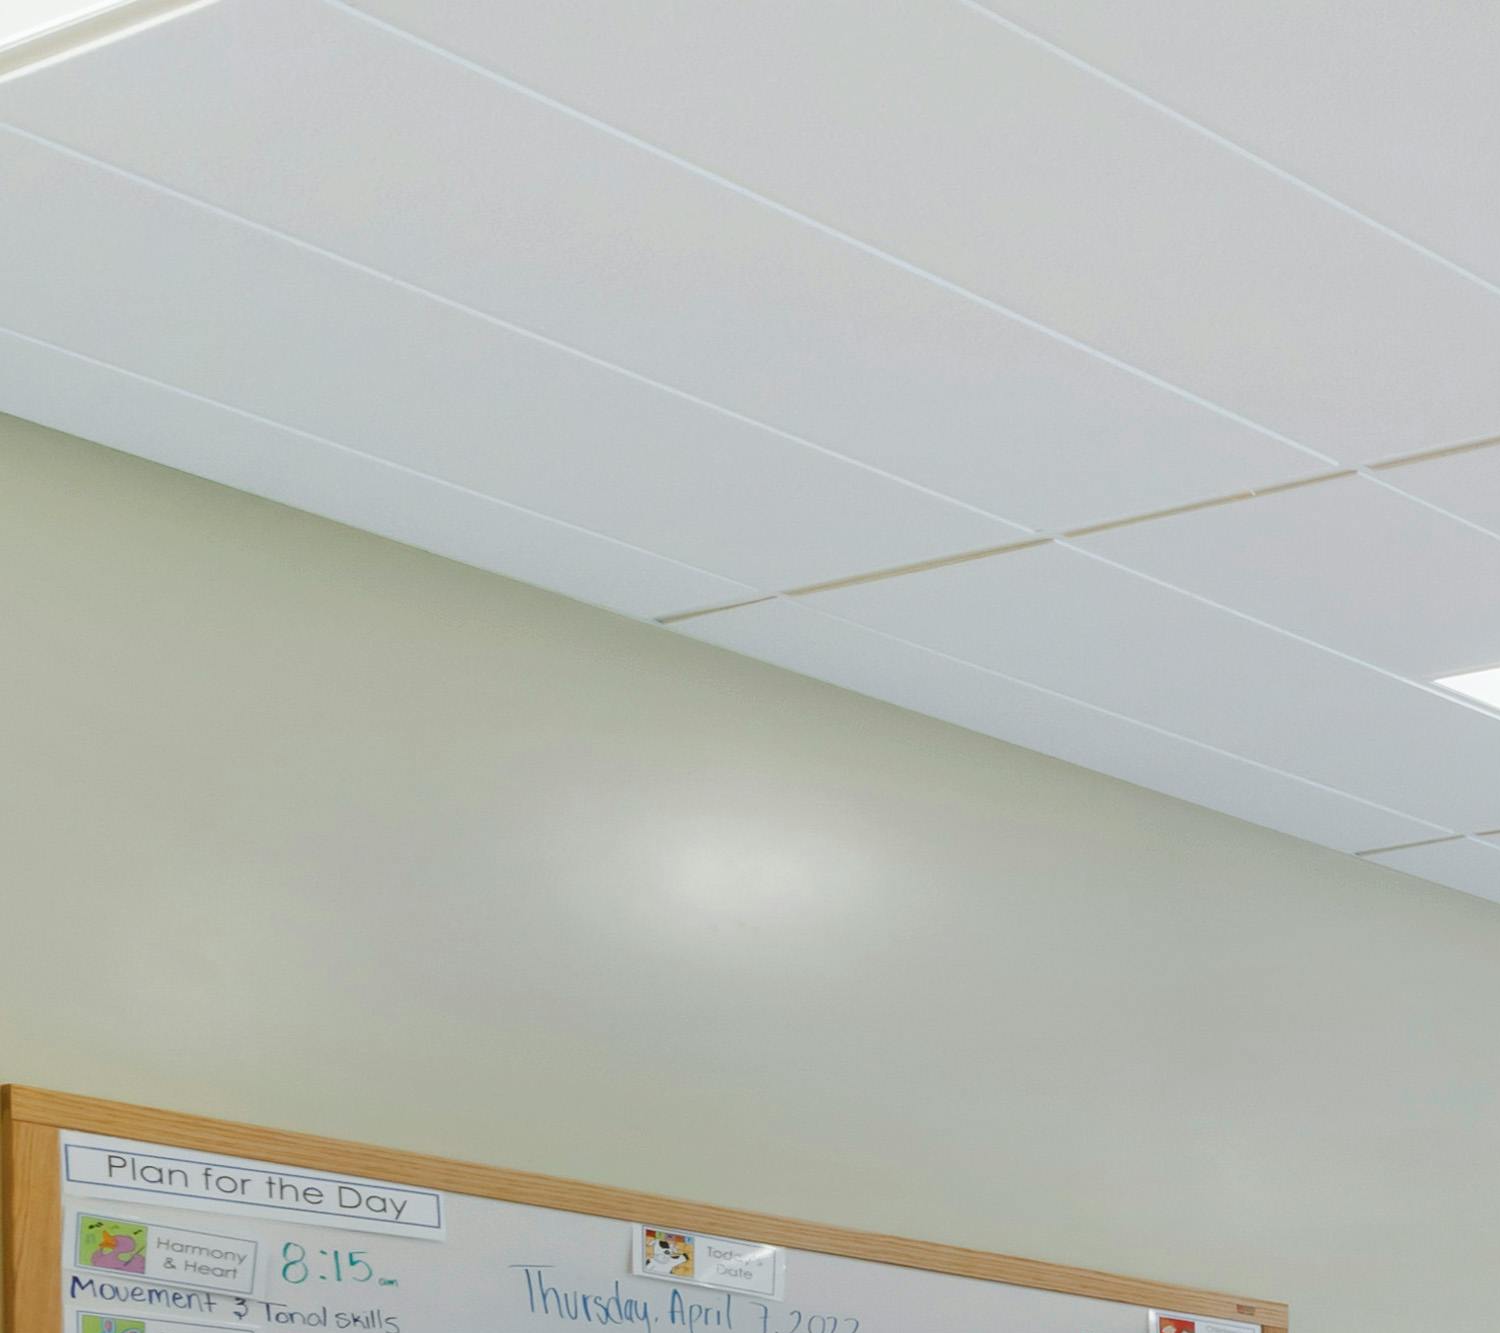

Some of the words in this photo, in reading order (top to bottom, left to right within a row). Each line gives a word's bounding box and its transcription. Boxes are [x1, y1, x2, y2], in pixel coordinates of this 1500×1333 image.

[107, 1155, 187, 1188] Plan
[202, 1167, 251, 1195] for
[266, 1176, 324, 1206] the
[339, 1185, 408, 1219] Day
[156, 1238, 247, 1263] Harmony
[163, 1257, 177, 1270] &
[184, 1260, 237, 1279] Heart
[717, 1264, 752, 1279] Date
[71, 1275, 216, 1313] Movement
[258, 1300, 327, 1327] Tonal
